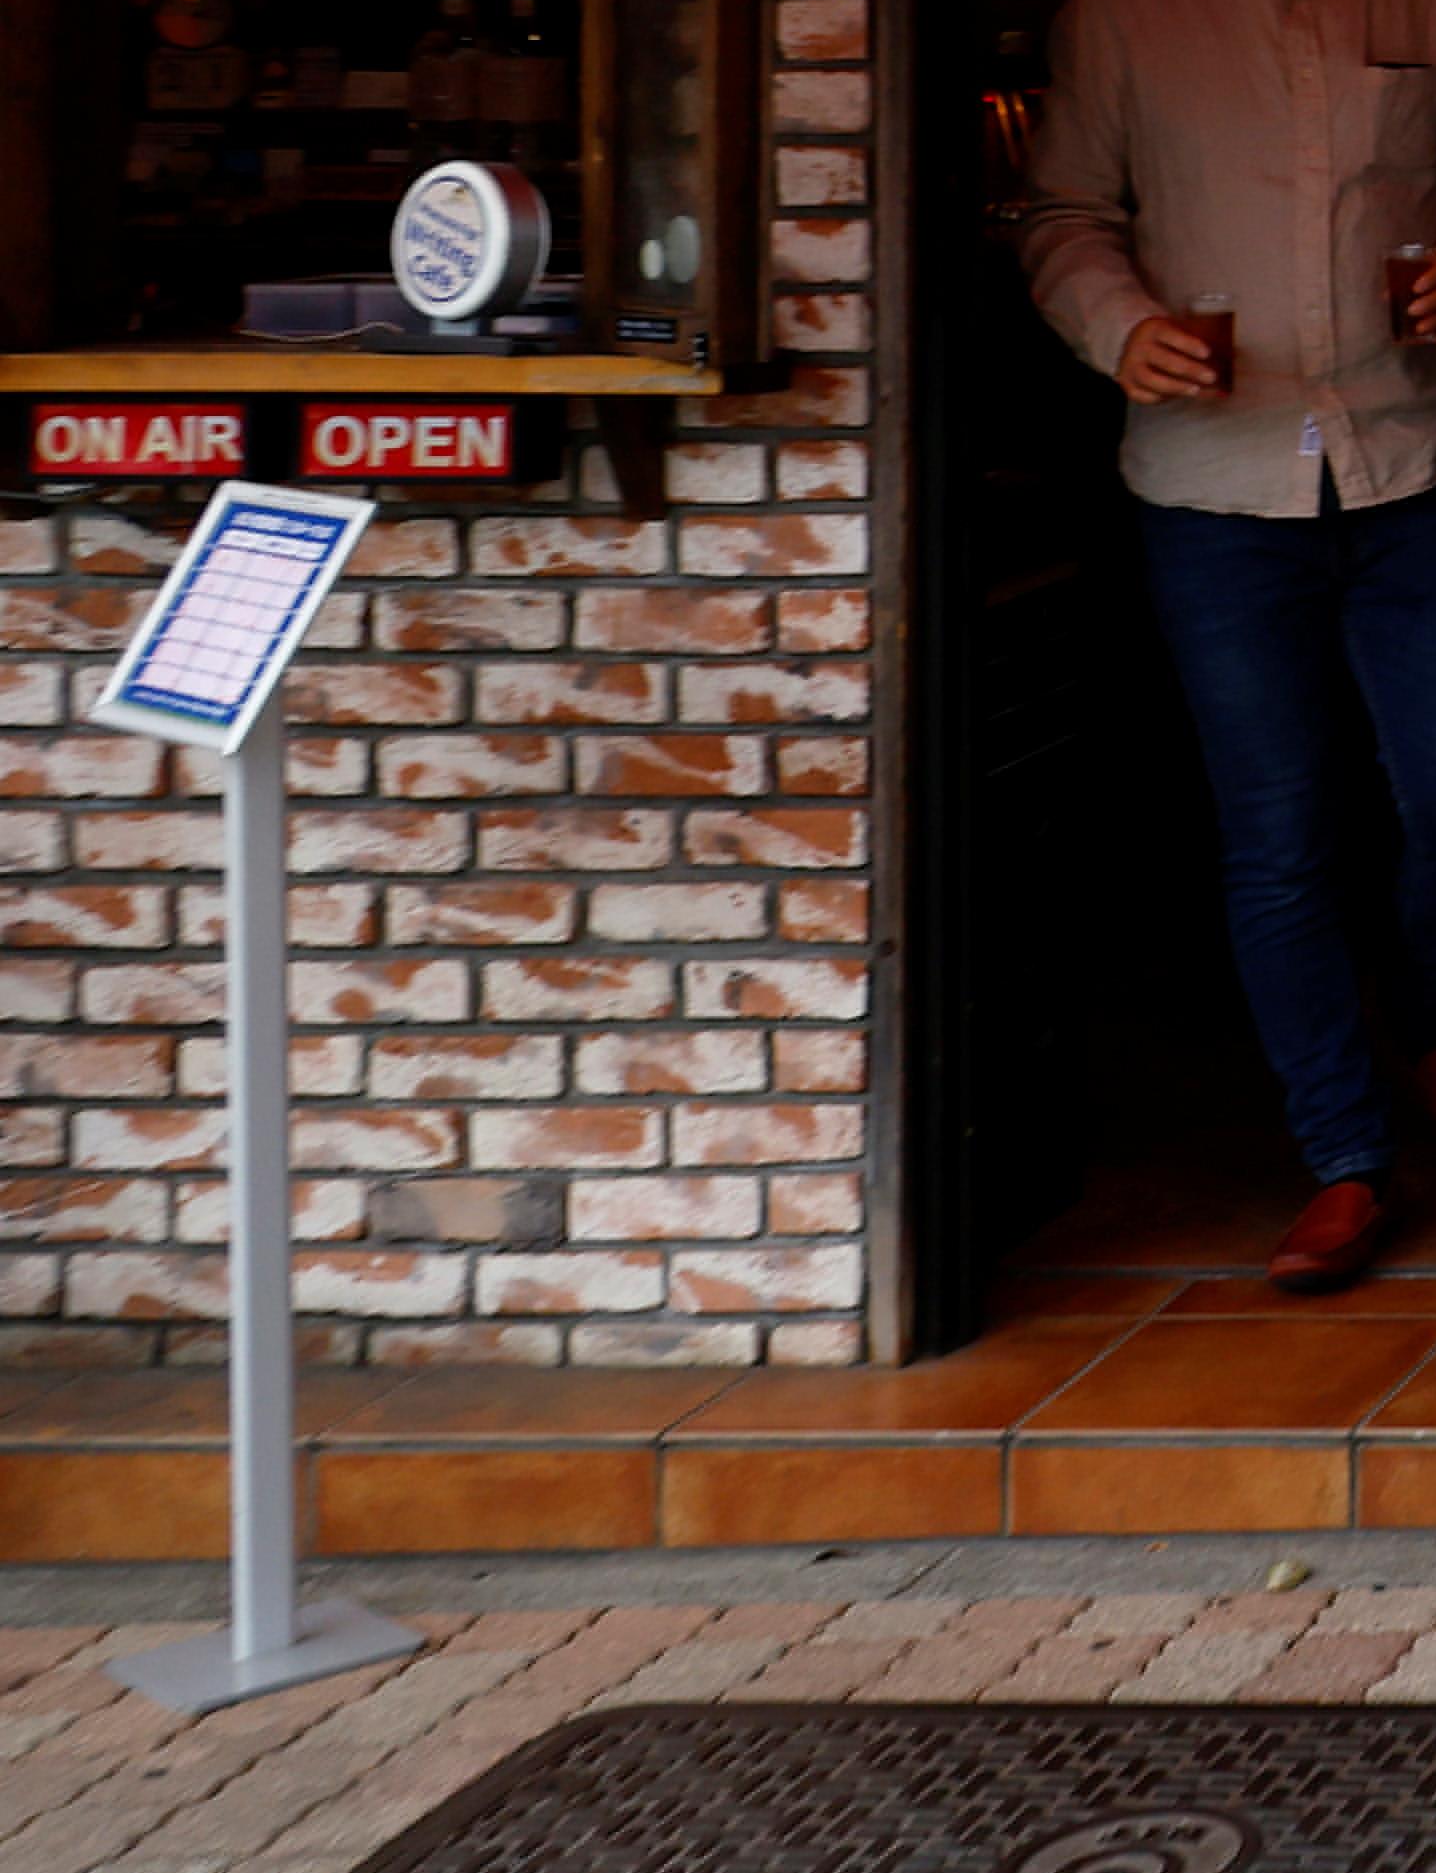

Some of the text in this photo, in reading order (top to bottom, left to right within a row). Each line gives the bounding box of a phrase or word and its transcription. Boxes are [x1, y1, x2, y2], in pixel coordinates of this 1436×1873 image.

[35, 415, 244, 463] ON AIR
[313, 415, 505, 468] OPEN
